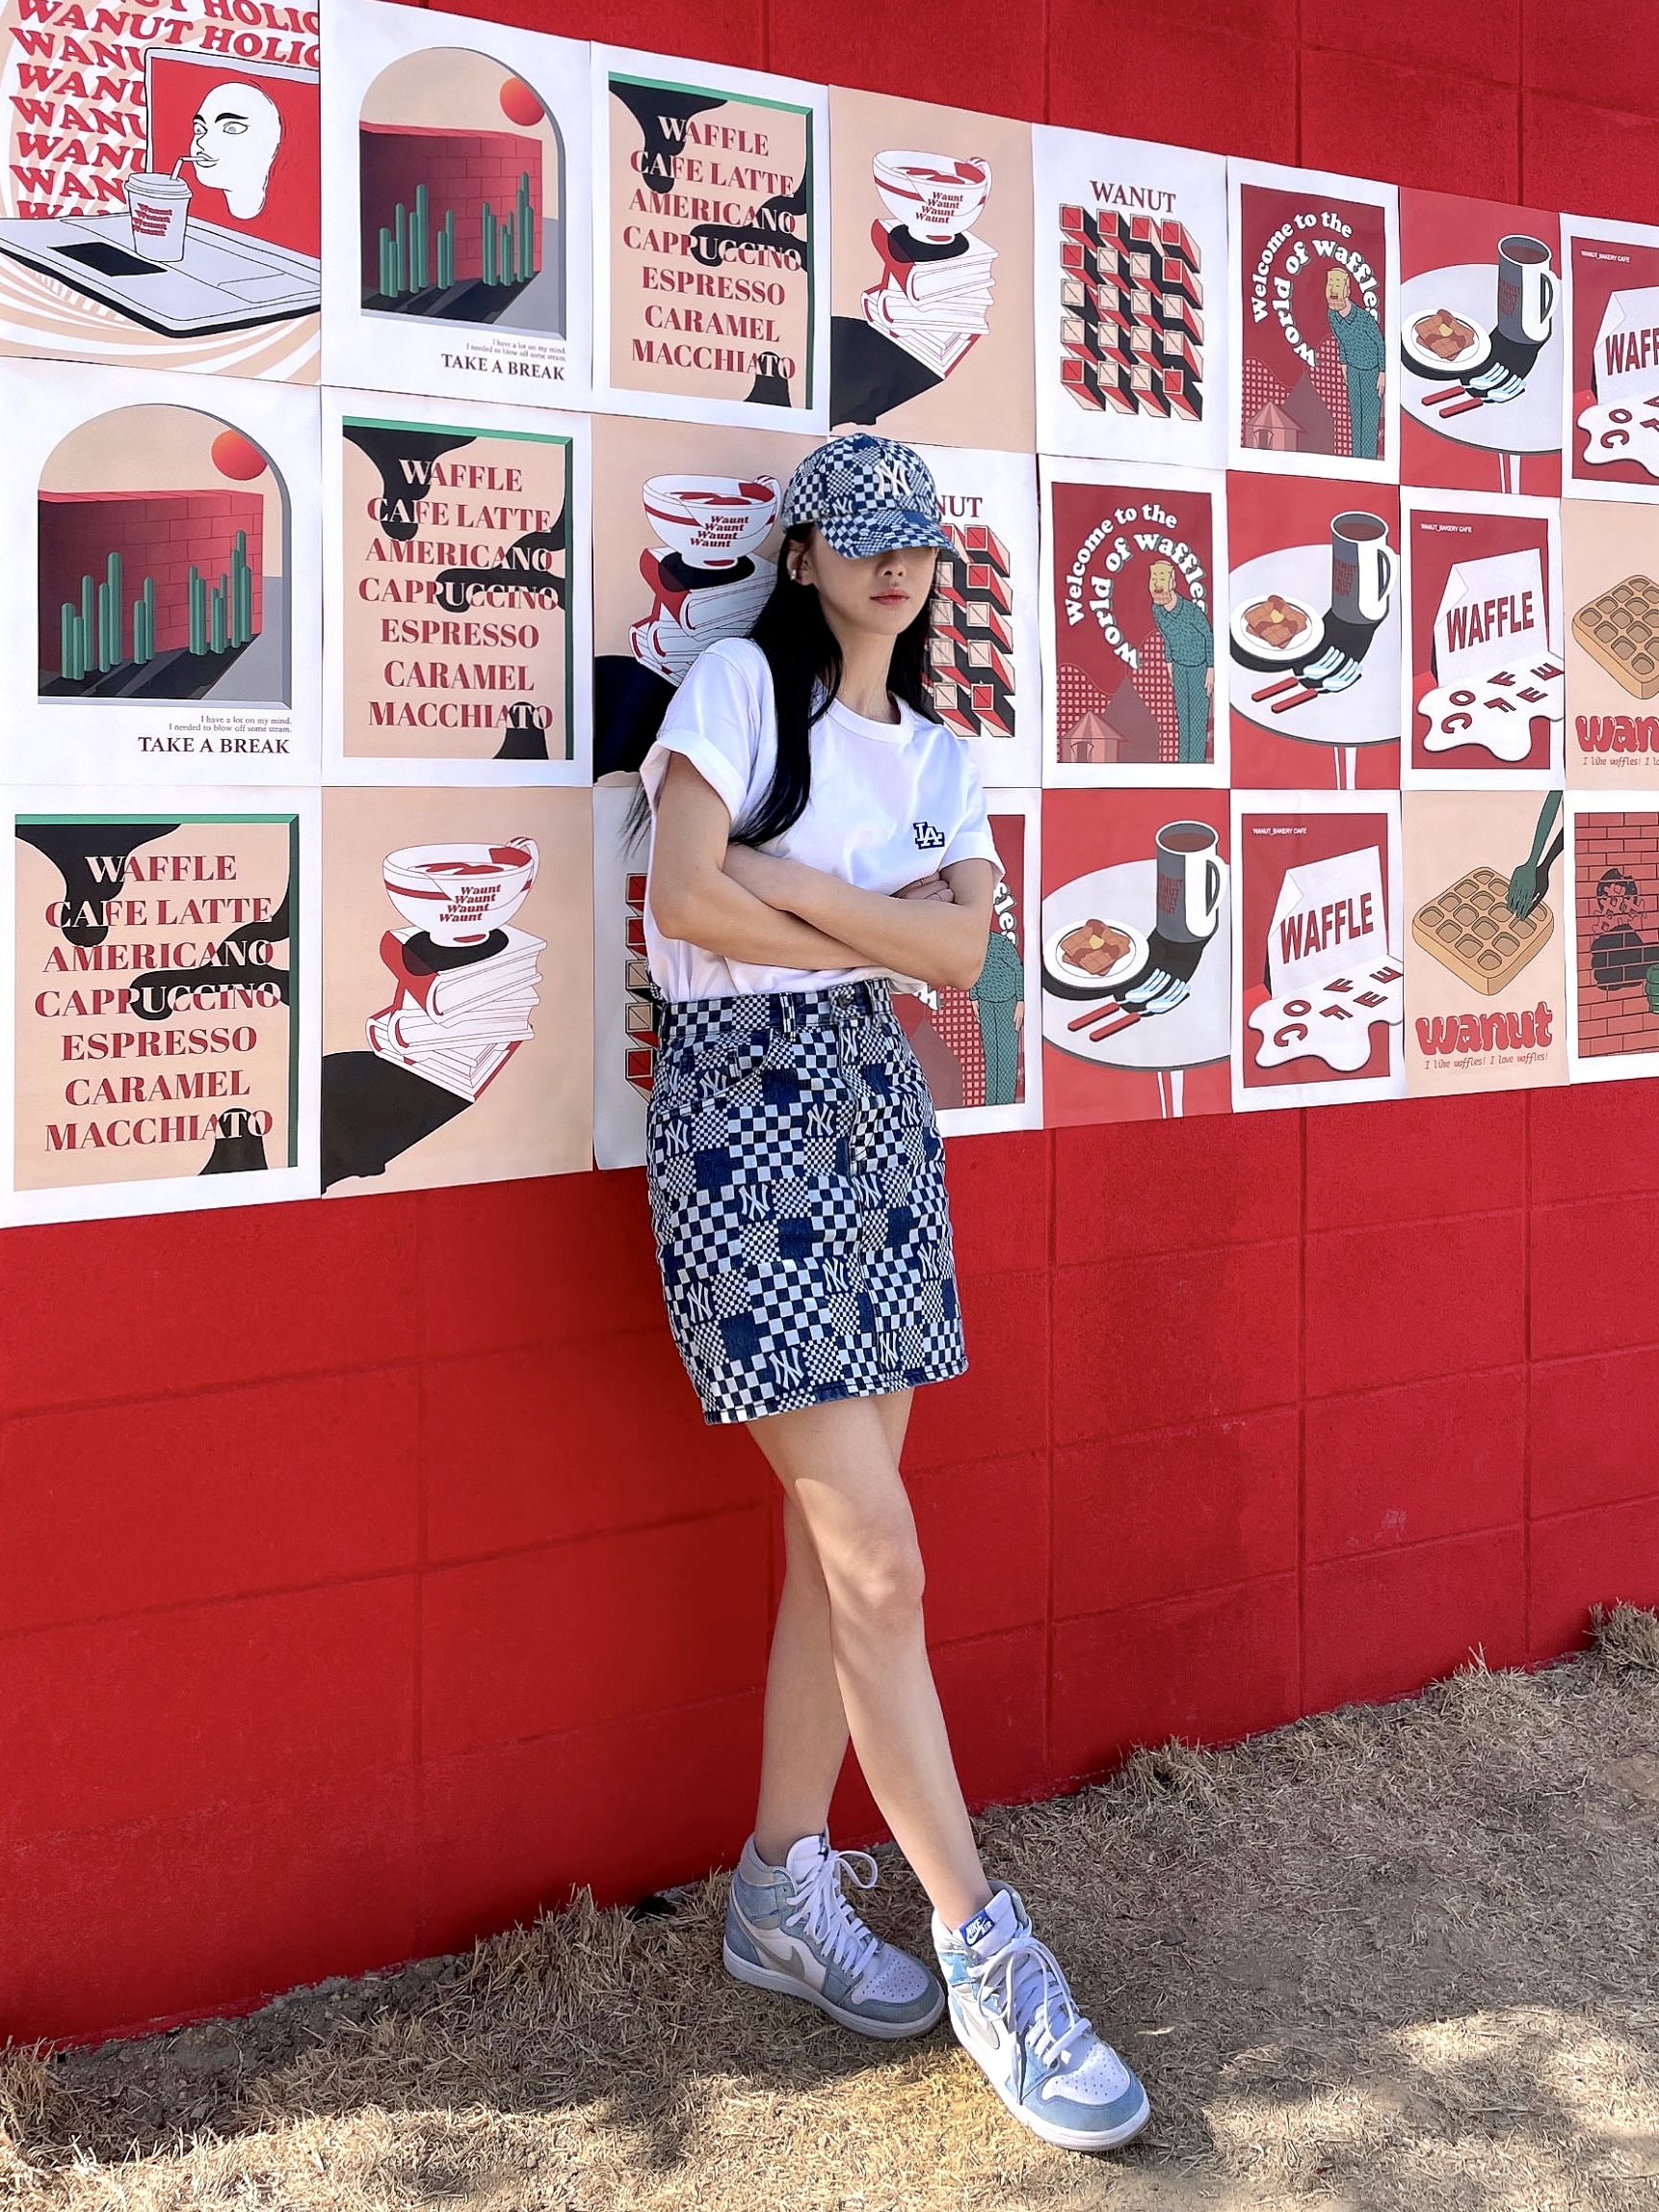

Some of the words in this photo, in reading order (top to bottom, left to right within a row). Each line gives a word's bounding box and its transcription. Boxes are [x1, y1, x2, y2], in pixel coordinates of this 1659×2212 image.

[17, 0, 193, 44] WANUT
[657, 116, 770, 156] WAFFLE
[630, 150, 703, 183] CAFE
[711, 162, 795, 198] LATTE
[628, 188, 796, 234] AMERICANO
[922, 205, 955, 217] Waunt
[928, 198, 960, 209] Waunt
[933, 192, 963, 202] Waunt
[1090, 180, 1176, 213] WANUT
[915, 212, 949, 224] Waunt
[623, 225, 802, 272] CAPPUCCINO
[1286, 241, 1310, 276] of
[1251, 223, 1294, 324] Welcome
[1294, 214, 1317, 229] to
[1321, 211, 1353, 238] the
[643, 266, 785, 306] ESPRESSO
[645, 304, 780, 342] CARAMEL
[441, 354, 487, 372] TAKE
[491, 359, 503, 374] A
[508, 361, 565, 381] BREAK
[632, 338, 796, 380] MACCHIATO
[399, 459, 523, 492] WAFFLE
[874, 460, 912, 497] NY
[367, 497, 449, 526] CAFE
[457, 503, 552, 534] LATTE
[711, 515, 750, 524] Waunt
[936, 494, 983, 517] NUT
[690, 538, 730, 547] Waunt
[698, 531, 738, 540] Waunt
[704, 523, 744, 532] Waunt
[365, 538, 552, 571] AMERICANO
[1065, 519, 1114, 626] Welcome
[1115, 507, 1137, 524] to
[1142, 503, 1177, 529] the
[1105, 537, 1131, 572] of
[358, 577, 559, 611] CAPPUCCINO
[381, 619, 540, 648] ESPRESSO
[1446, 591, 1535, 653] WAFFLE
[383, 660, 535, 691] CARAMEL
[368, 701, 553, 730] MACCHIATO
[138, 737, 194, 752] TAKE
[199, 738, 214, 753] A
[220, 738, 290, 753] BREAK
[914, 823, 944, 849] LA
[85, 855, 237, 883] WAFFLE
[455, 894, 496, 904] Waunt
[461, 884, 502, 895] Waunt
[45, 900, 146, 928] CAFE
[156, 897, 273, 926] LATTE
[439, 913, 484, 923] Waunt
[447, 904, 490, 913] Waunt
[1280, 892, 1374, 964] WAFFLE
[42, 940, 274, 973] AMERICANO
[35, 983, 281, 1017] CAPPUCCINO
[61, 1026, 257, 1061] ESPRESSO
[1415, 1001, 1553, 1055] wanut
[1425, 1060, 1431, 1069] I
[1434, 1060, 1450, 1069] like
[1454, 1057, 1486, 1070] waffles!
[1489, 1055, 1495, 1065] I
[1498, 1054, 1514, 1065] love
[1516, 1052, 1548, 1065] waffles!
[66, 1069, 250, 1106] CARAMEL
[45, 1110, 273, 1151] MACCHIATO
